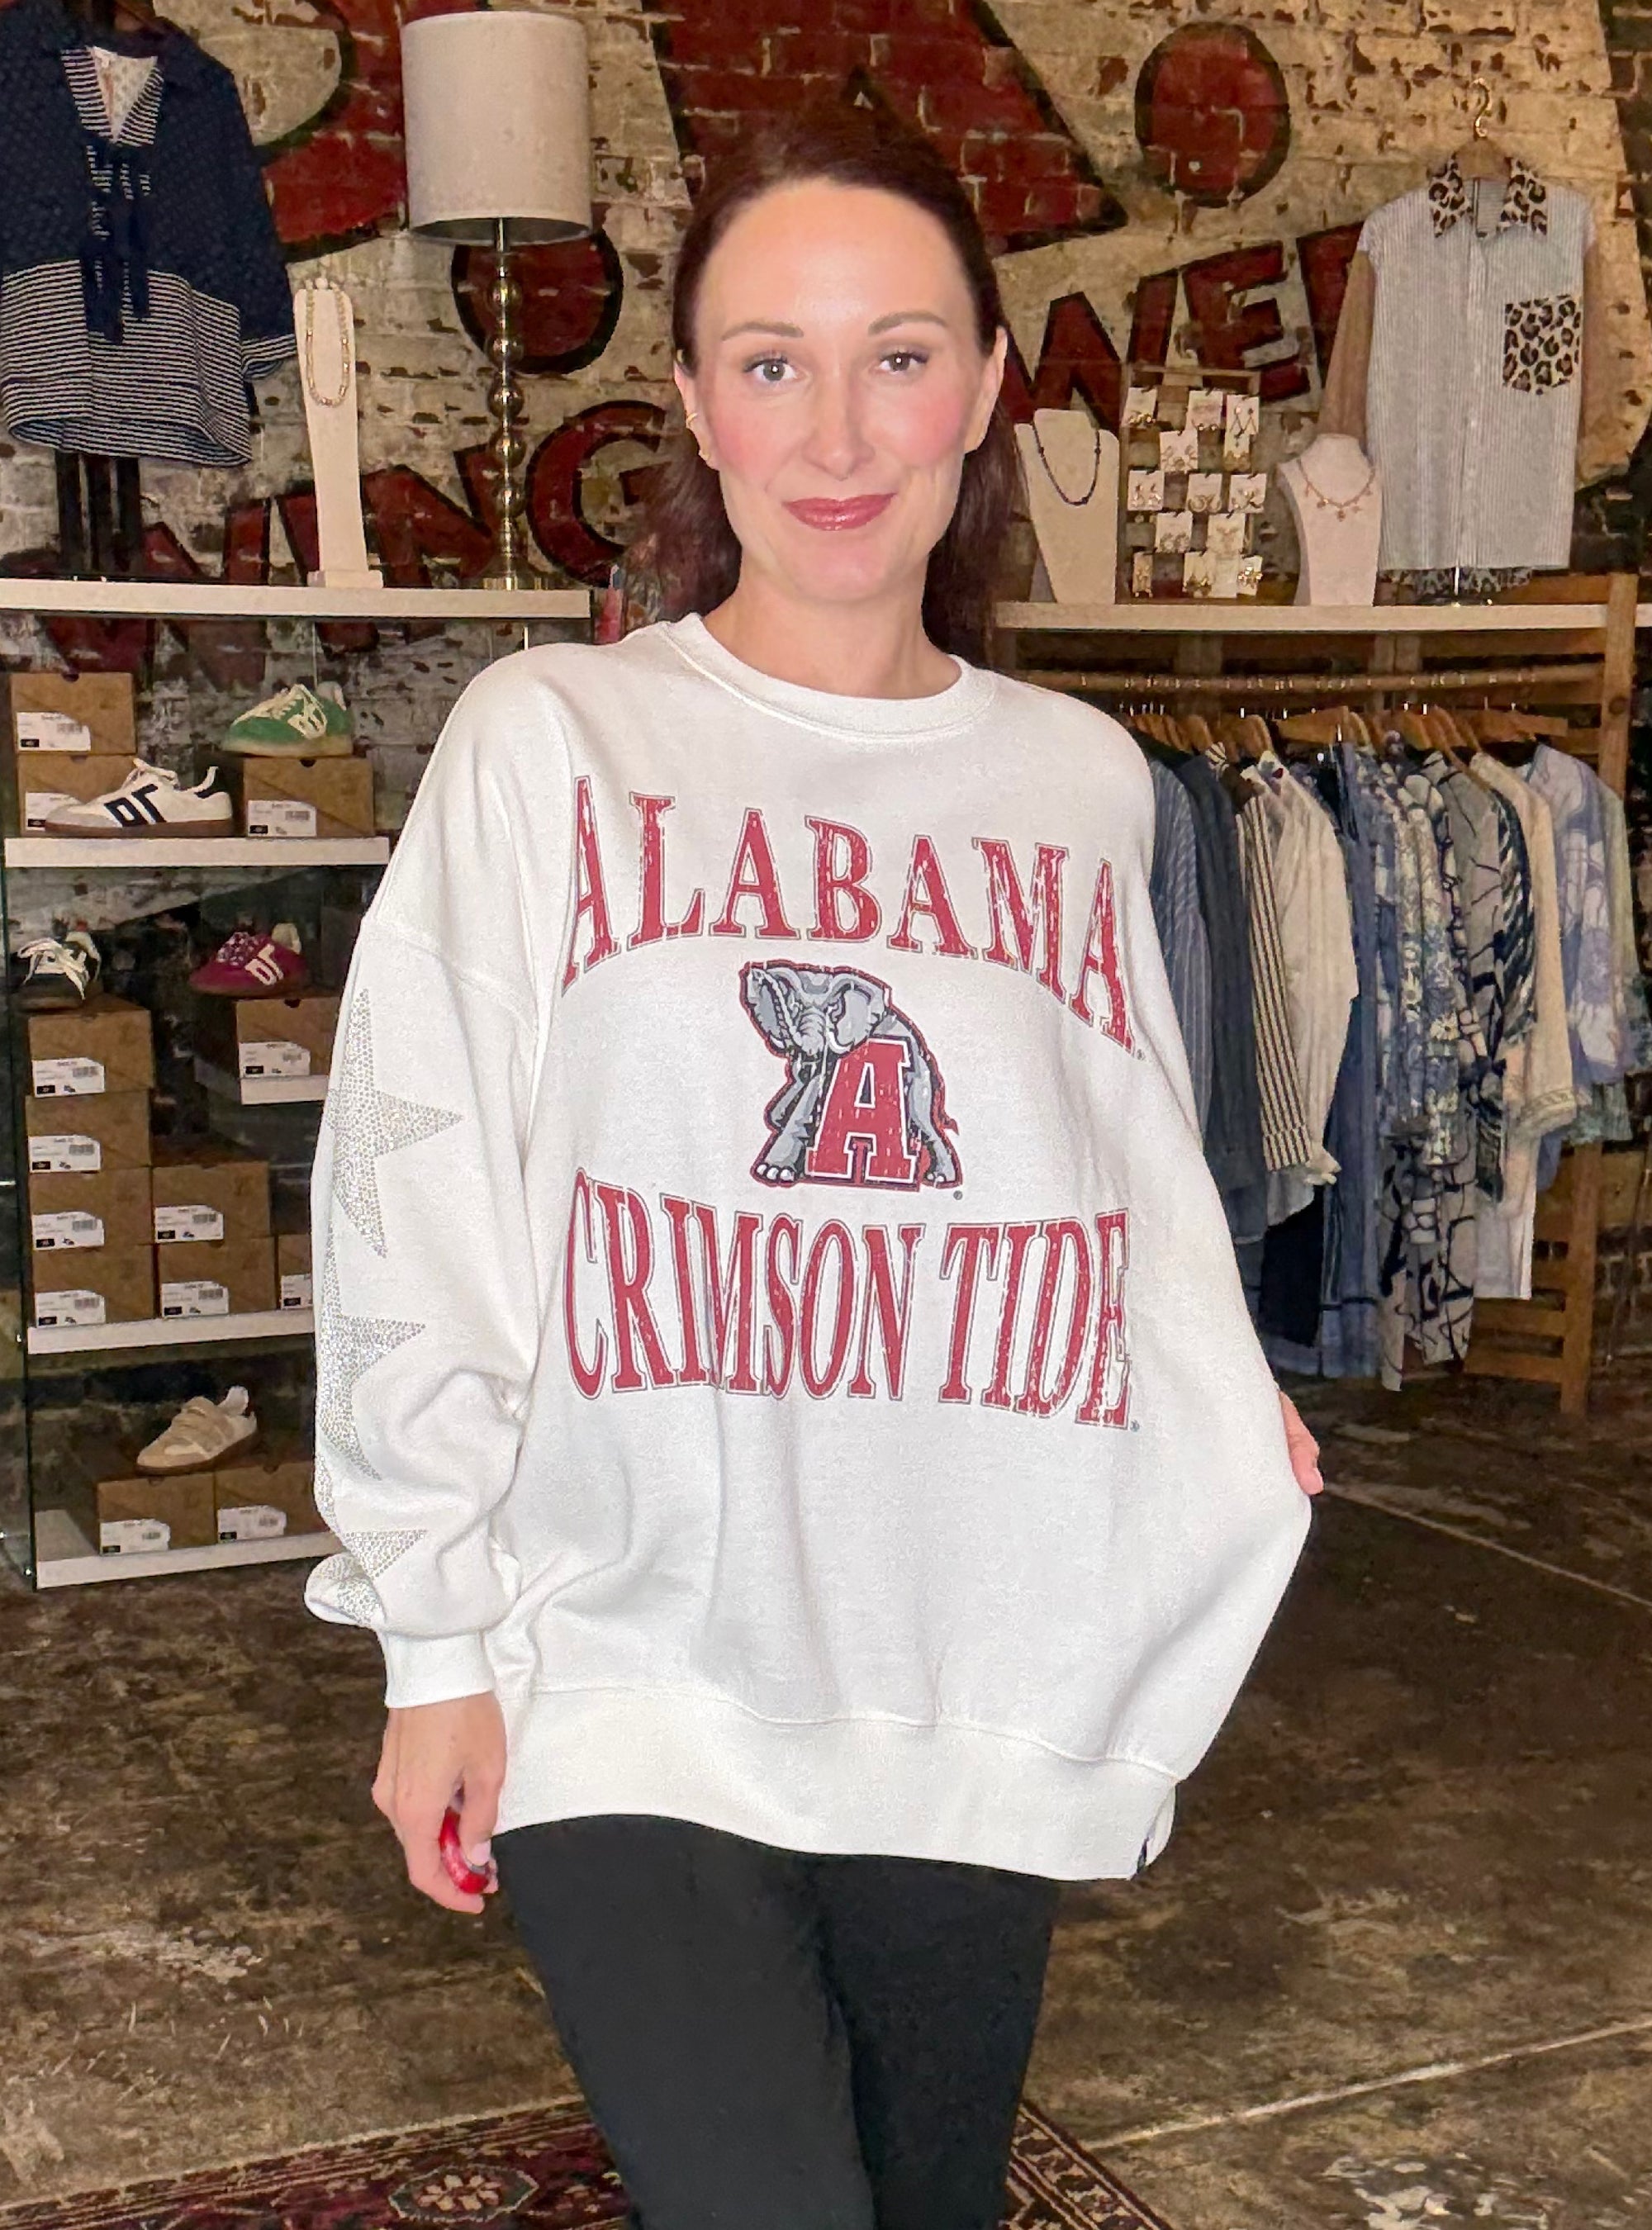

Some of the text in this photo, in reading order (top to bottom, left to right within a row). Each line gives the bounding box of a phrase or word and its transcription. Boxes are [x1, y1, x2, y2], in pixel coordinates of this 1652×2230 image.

[562, 775, 1135, 1058] ALABAMA
[803, 1033, 919, 1185] A
[563, 1167, 1131, 1431] CRIMSON TIDE
